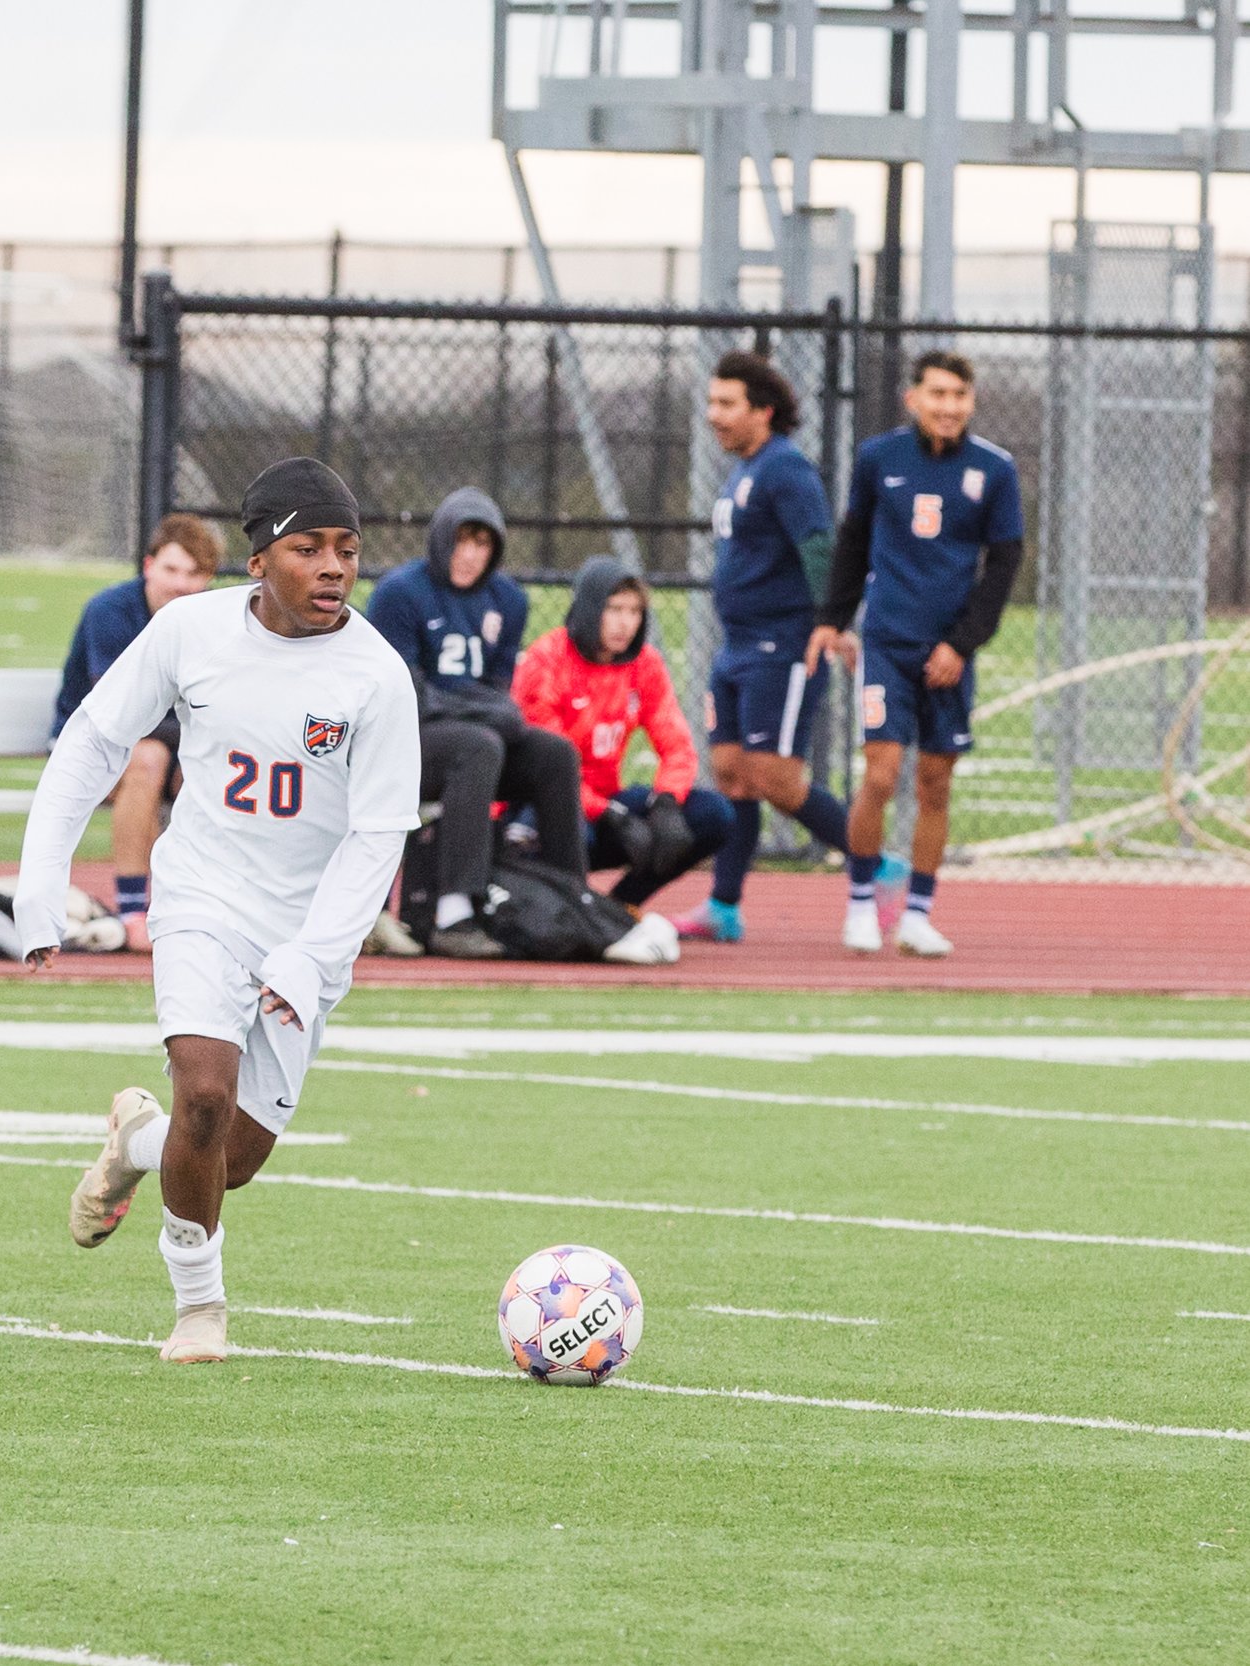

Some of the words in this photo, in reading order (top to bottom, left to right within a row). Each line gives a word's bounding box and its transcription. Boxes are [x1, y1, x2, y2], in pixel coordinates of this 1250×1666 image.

[911, 493, 943, 539] 5
[437, 632, 484, 678] 21
[224, 750, 303, 818] 20
[548, 1298, 617, 1359] SELECT
